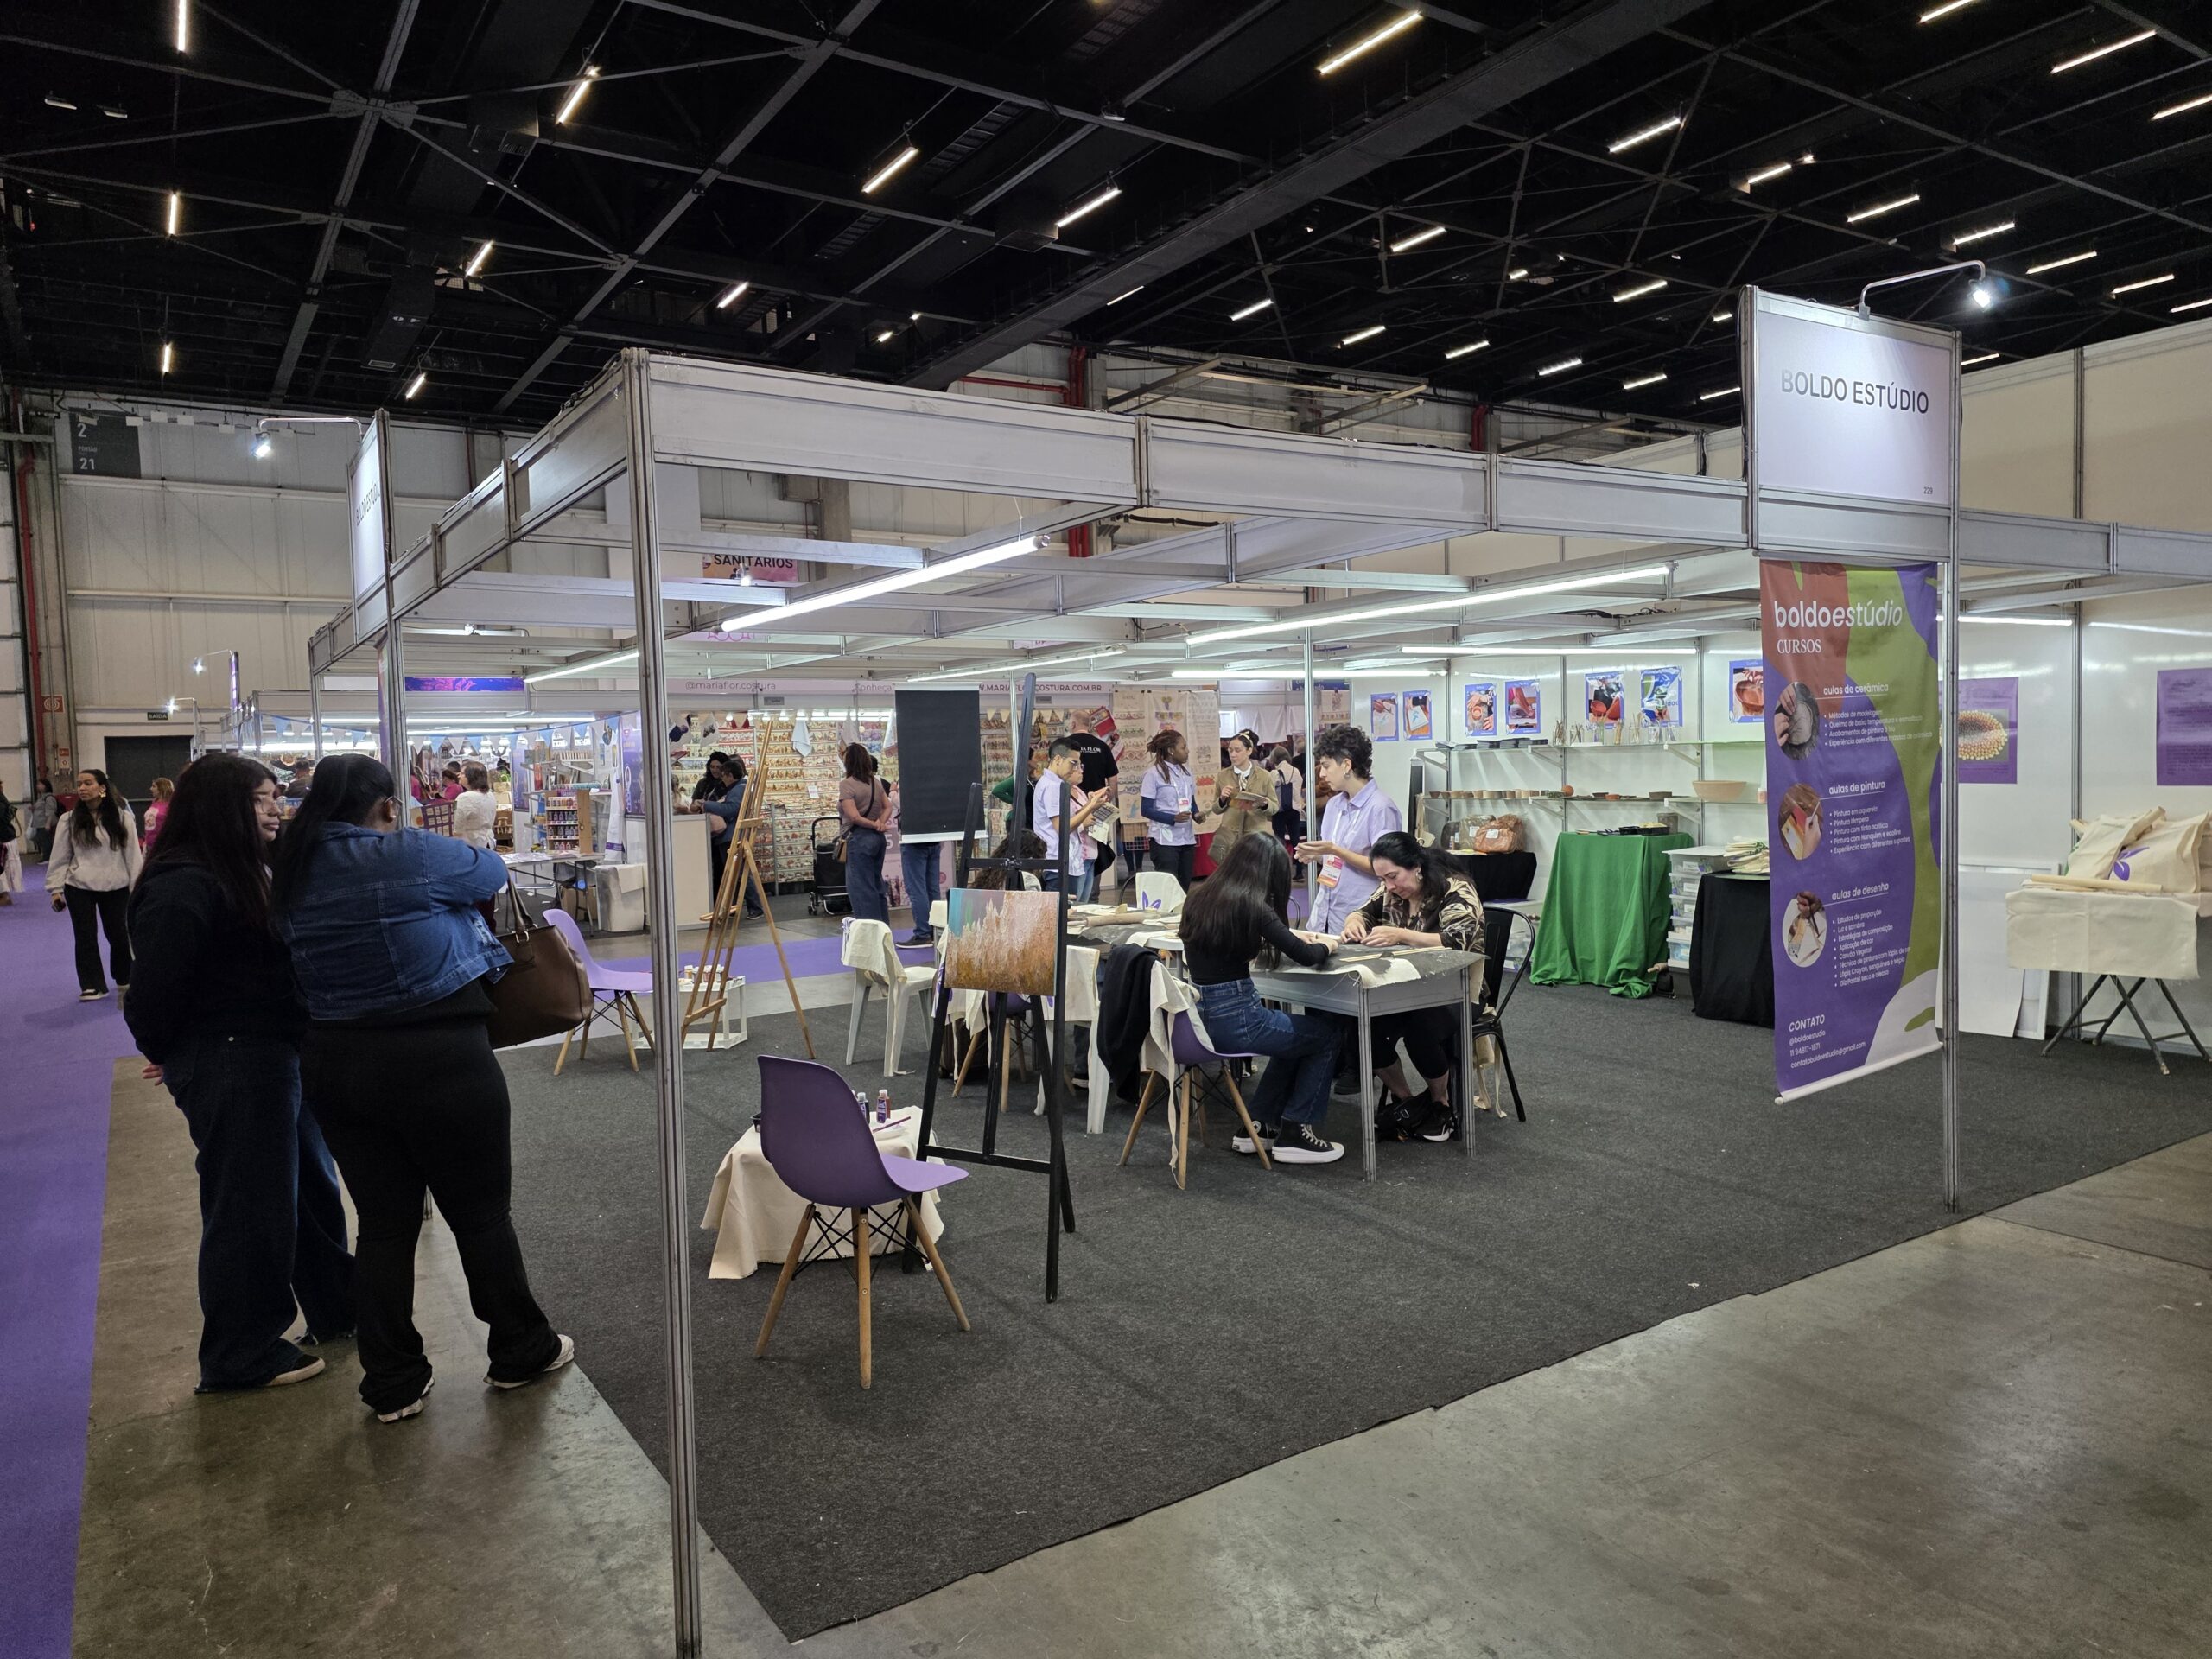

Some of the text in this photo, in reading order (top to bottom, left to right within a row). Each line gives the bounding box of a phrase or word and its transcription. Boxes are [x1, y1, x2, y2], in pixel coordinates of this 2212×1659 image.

[1782, 369, 1929, 414] BOLDO ESTÚDIO
[78, 423, 86, 437] 2
[80, 458, 94, 469] 21
[1775, 599, 1901, 627] boldoestúdio
[1777, 639, 1821, 654] CURSOS
[686, 681, 776, 690] @mariaflor.costura
[1824, 683, 1888, 695] aulas de cerâmica
[1829, 781, 1885, 794] aulas de pintura
[1832, 883, 1889, 900] aulas de desenho
[1789, 1014, 1825, 1032] CONTATO
